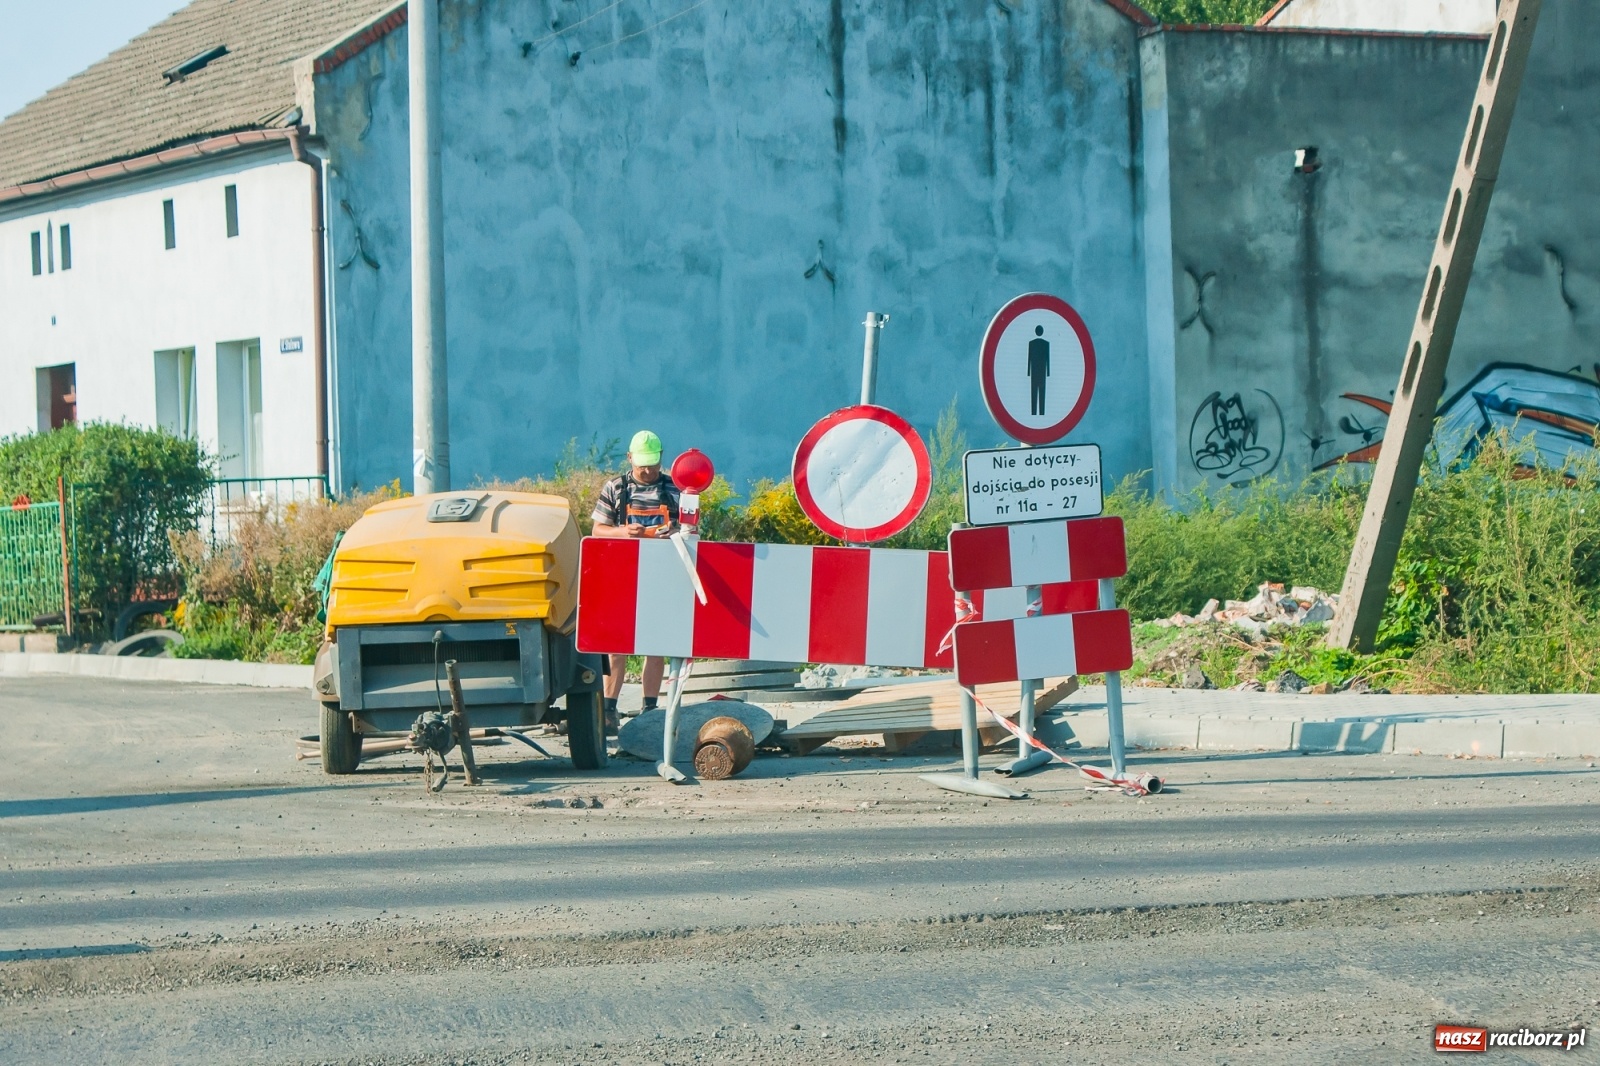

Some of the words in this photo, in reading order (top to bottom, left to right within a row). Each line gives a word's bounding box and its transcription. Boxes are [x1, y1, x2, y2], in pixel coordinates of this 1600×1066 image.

[992, 455, 1016, 469] Nie
[1024, 453, 1077, 468] dotyczy
[972, 478, 1021, 495] dojścia
[1028, 476, 1046, 489] do
[1050, 471, 1098, 491] posesji
[996, 504, 1010, 515] nr
[1017, 500, 1038, 512] 11a
[1062, 495, 1078, 509] 27
